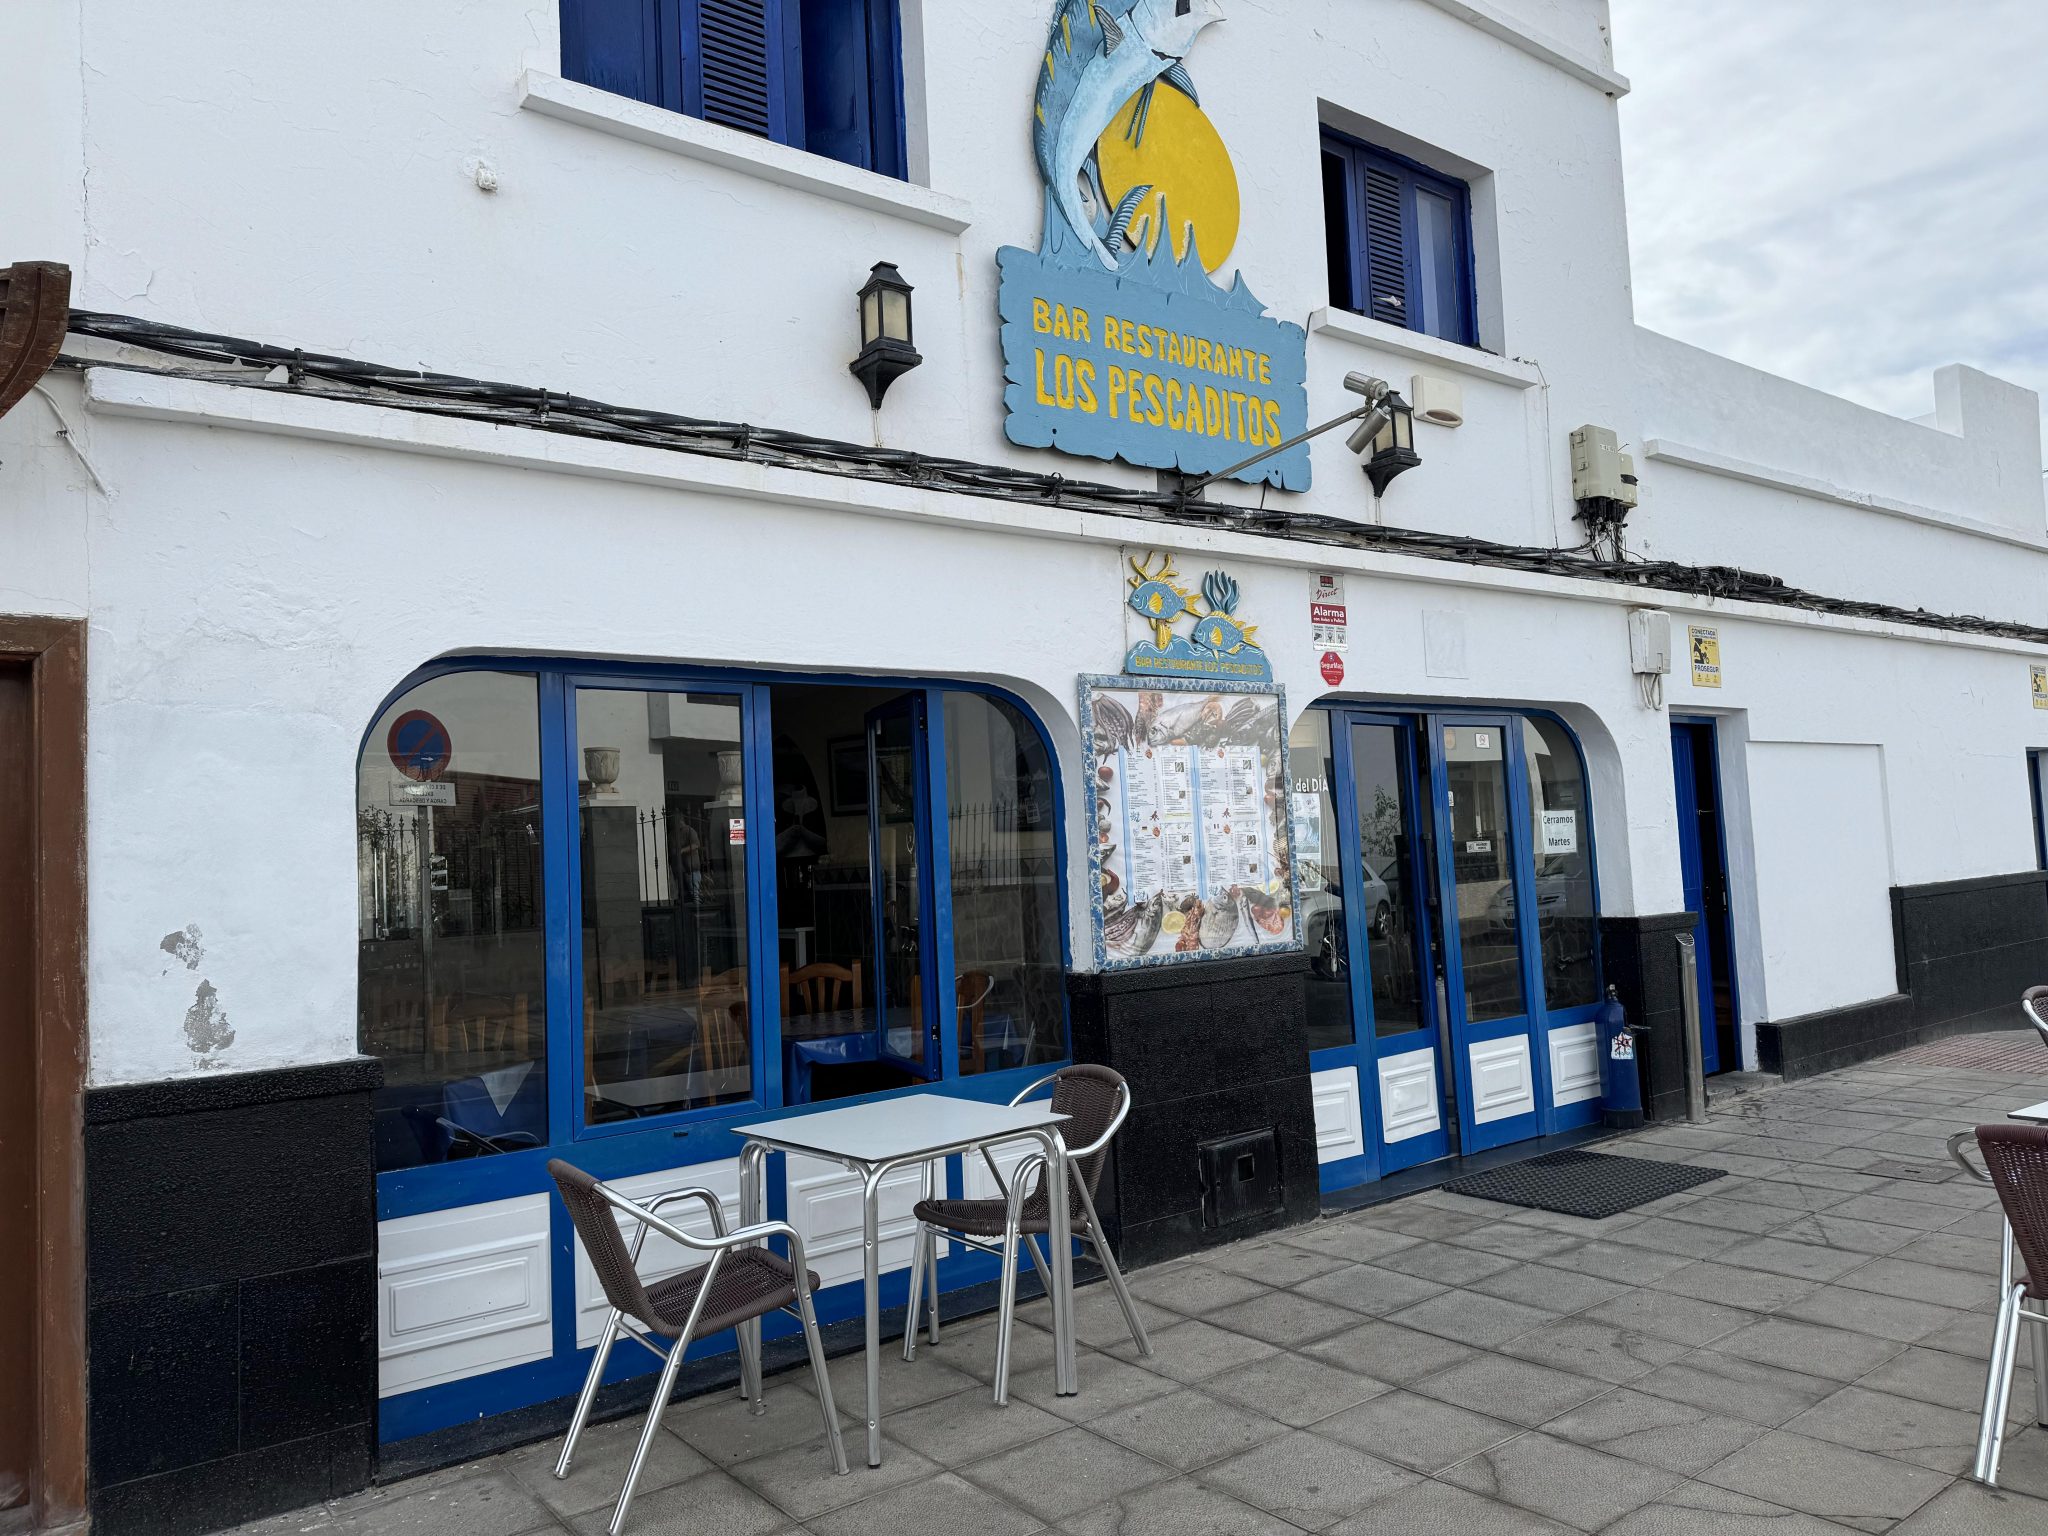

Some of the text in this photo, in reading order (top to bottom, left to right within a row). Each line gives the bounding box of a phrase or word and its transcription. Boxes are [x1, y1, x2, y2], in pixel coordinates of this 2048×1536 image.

[1033, 297, 1272, 385] BAR RESTAURANTE
[1034, 348, 1282, 449] LOS PESCADITOS
[1313, 606, 1345, 618] Alarma
[1135, 656, 1151, 667] BAR
[1154, 657, 1204, 671] RESTAURANTE
[1205, 661, 1218, 673] LOS
[1296, 775, 1329, 792] del DÍA
[1543, 815, 1574, 824] Cerramos
[1549, 837, 1571, 846] Martes
